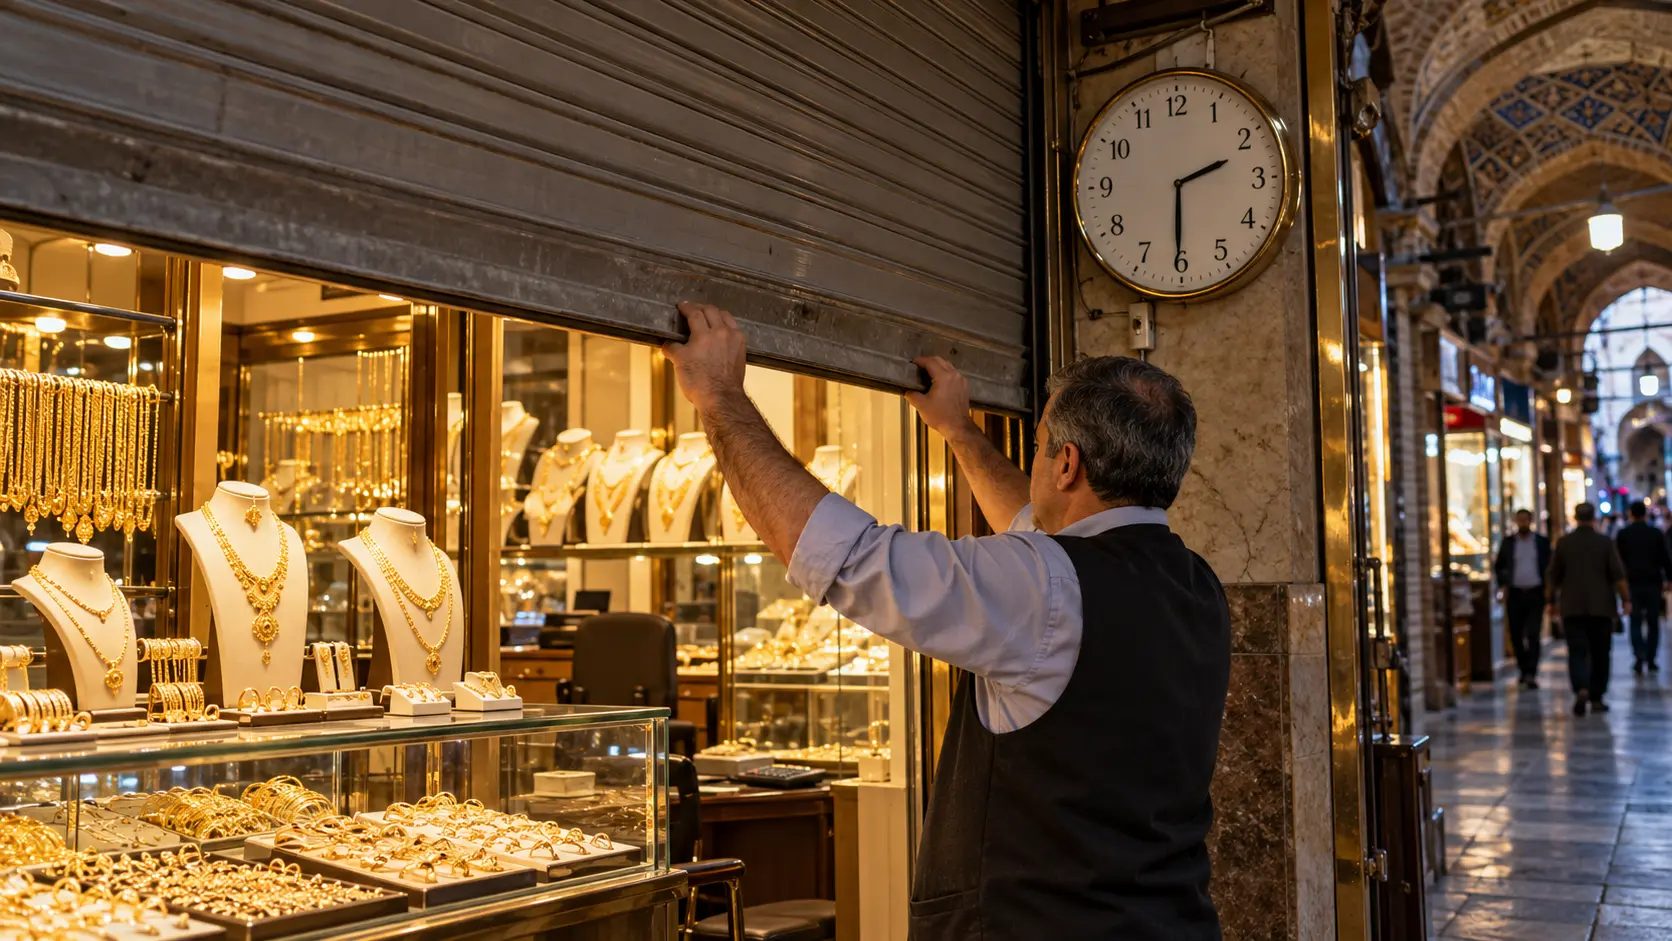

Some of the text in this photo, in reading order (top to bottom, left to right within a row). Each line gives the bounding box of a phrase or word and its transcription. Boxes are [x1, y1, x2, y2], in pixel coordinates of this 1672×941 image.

[1166, 95, 1187, 117] 12
[1210, 102, 1217, 123] 1
[1135, 109, 1150, 129] 11
[1110, 139, 1130, 159] 10
[1238, 128, 1251, 150] 2
[1100, 177, 1112, 198] 9
[1252, 167, 1265, 189] 3
[1111, 214, 1124, 236] 8
[1241, 207, 1256, 229] 4
[1139, 241, 1151, 263] 7
[1214, 239, 1227, 261] 5
[1173, 250, 1188, 273] 6
